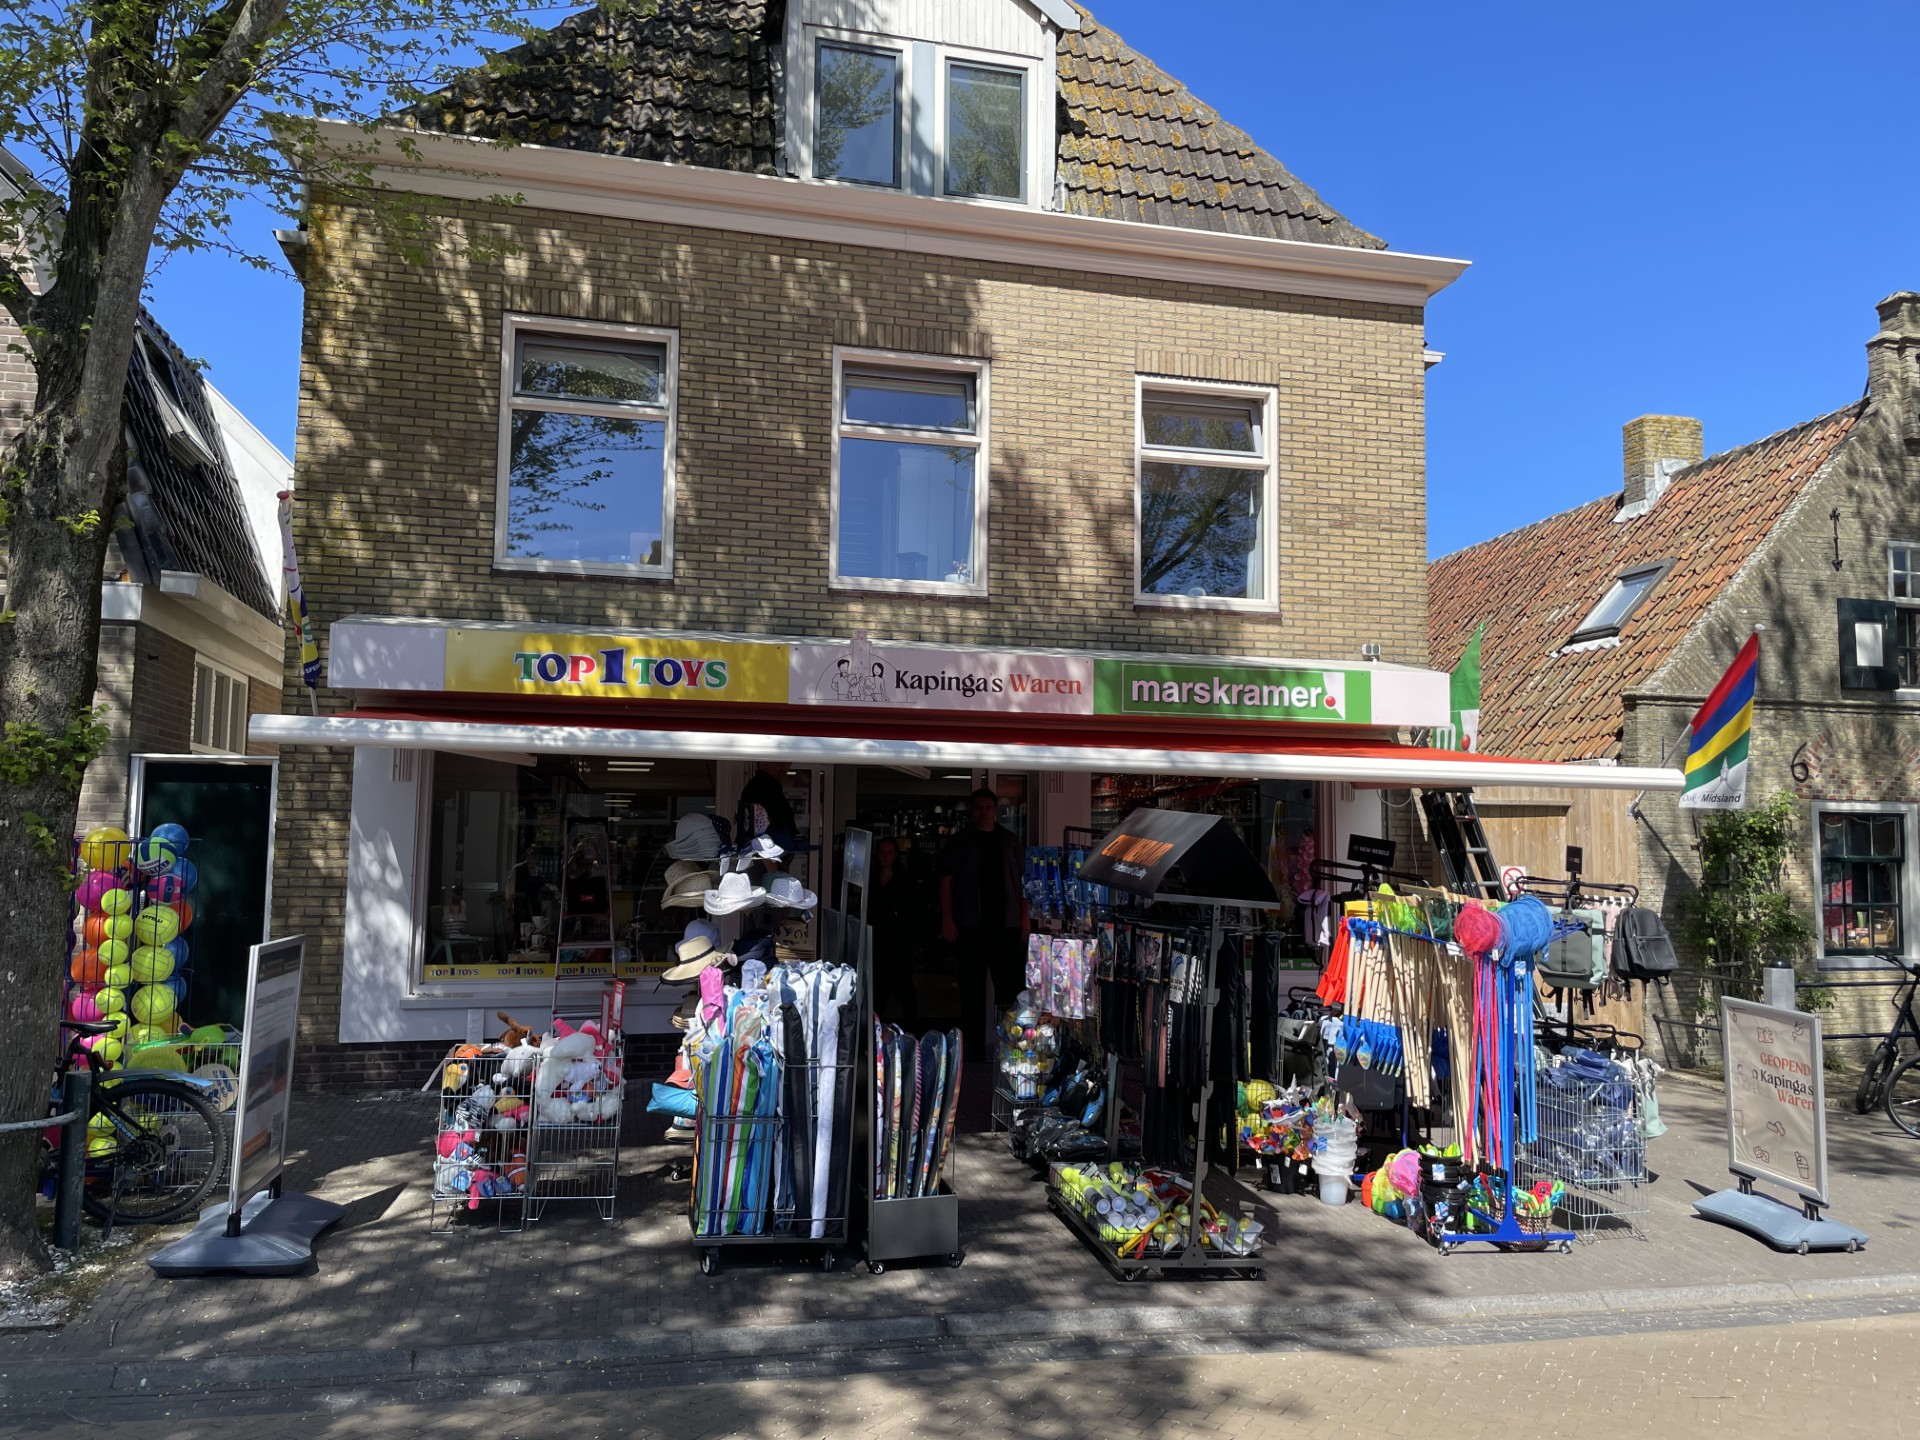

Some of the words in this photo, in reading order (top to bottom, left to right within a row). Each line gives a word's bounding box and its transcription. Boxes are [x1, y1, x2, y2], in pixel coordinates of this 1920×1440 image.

[514, 651, 595, 685] TOP
[599, 647, 627, 685] 1
[631, 657, 729, 689] TOYS
[895, 669, 1003, 698] Kapinga's
[1009, 673, 1082, 695] Waren
[1131, 676, 1322, 708] marskramer
[1700, 792, 1742, 803] Midsland
[431, 968, 449, 976] TOP
[457, 968, 480, 976] TOYS
[497, 967, 514, 975] TOP
[523, 967, 545, 975] TOYS
[587, 966, 608, 974] TOYS
[649, 965, 668, 973] TOY
[1759, 1052, 1811, 1077] GEOPEND
[1777, 1089, 1815, 1111] Waren
